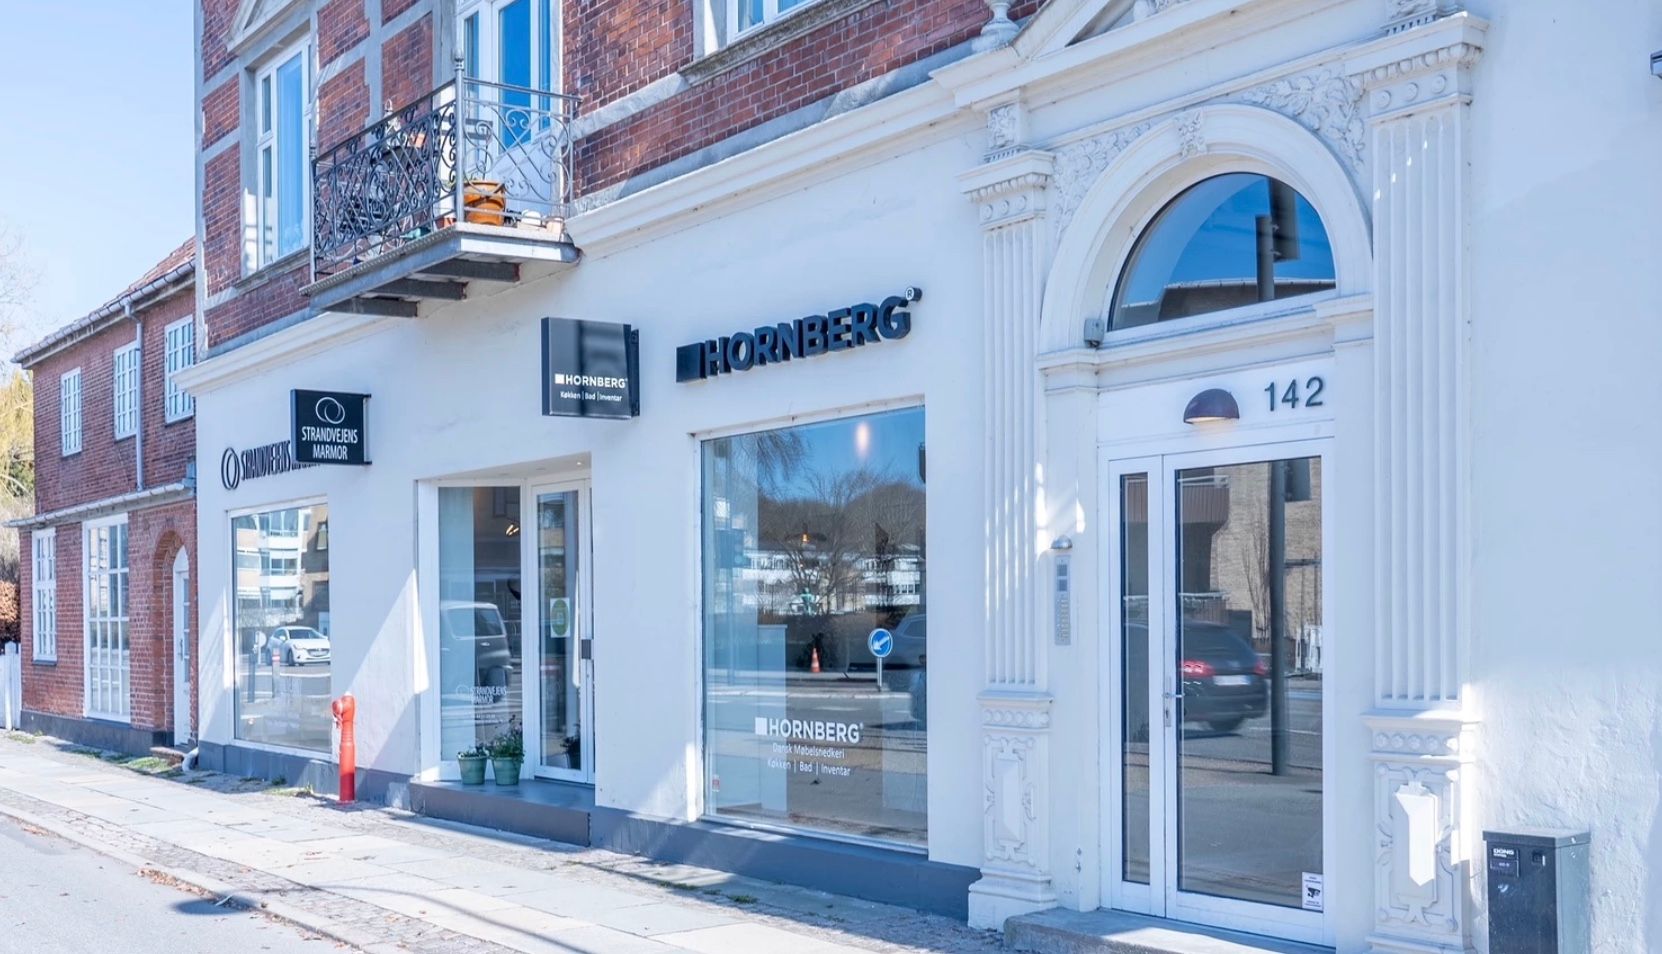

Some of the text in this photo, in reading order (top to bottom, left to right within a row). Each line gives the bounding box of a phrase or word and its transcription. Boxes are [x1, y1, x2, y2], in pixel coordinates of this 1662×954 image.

[584, 392, 596, 400] Bad
[1264, 376, 1324, 412] 142
[301, 426, 358, 444] STRANDVEJENS
[312, 443, 348, 460] MARMOR
[772, 742, 792, 754] Dansk
[799, 761, 813, 773] Bad
[821, 764, 851, 777] Inventar
